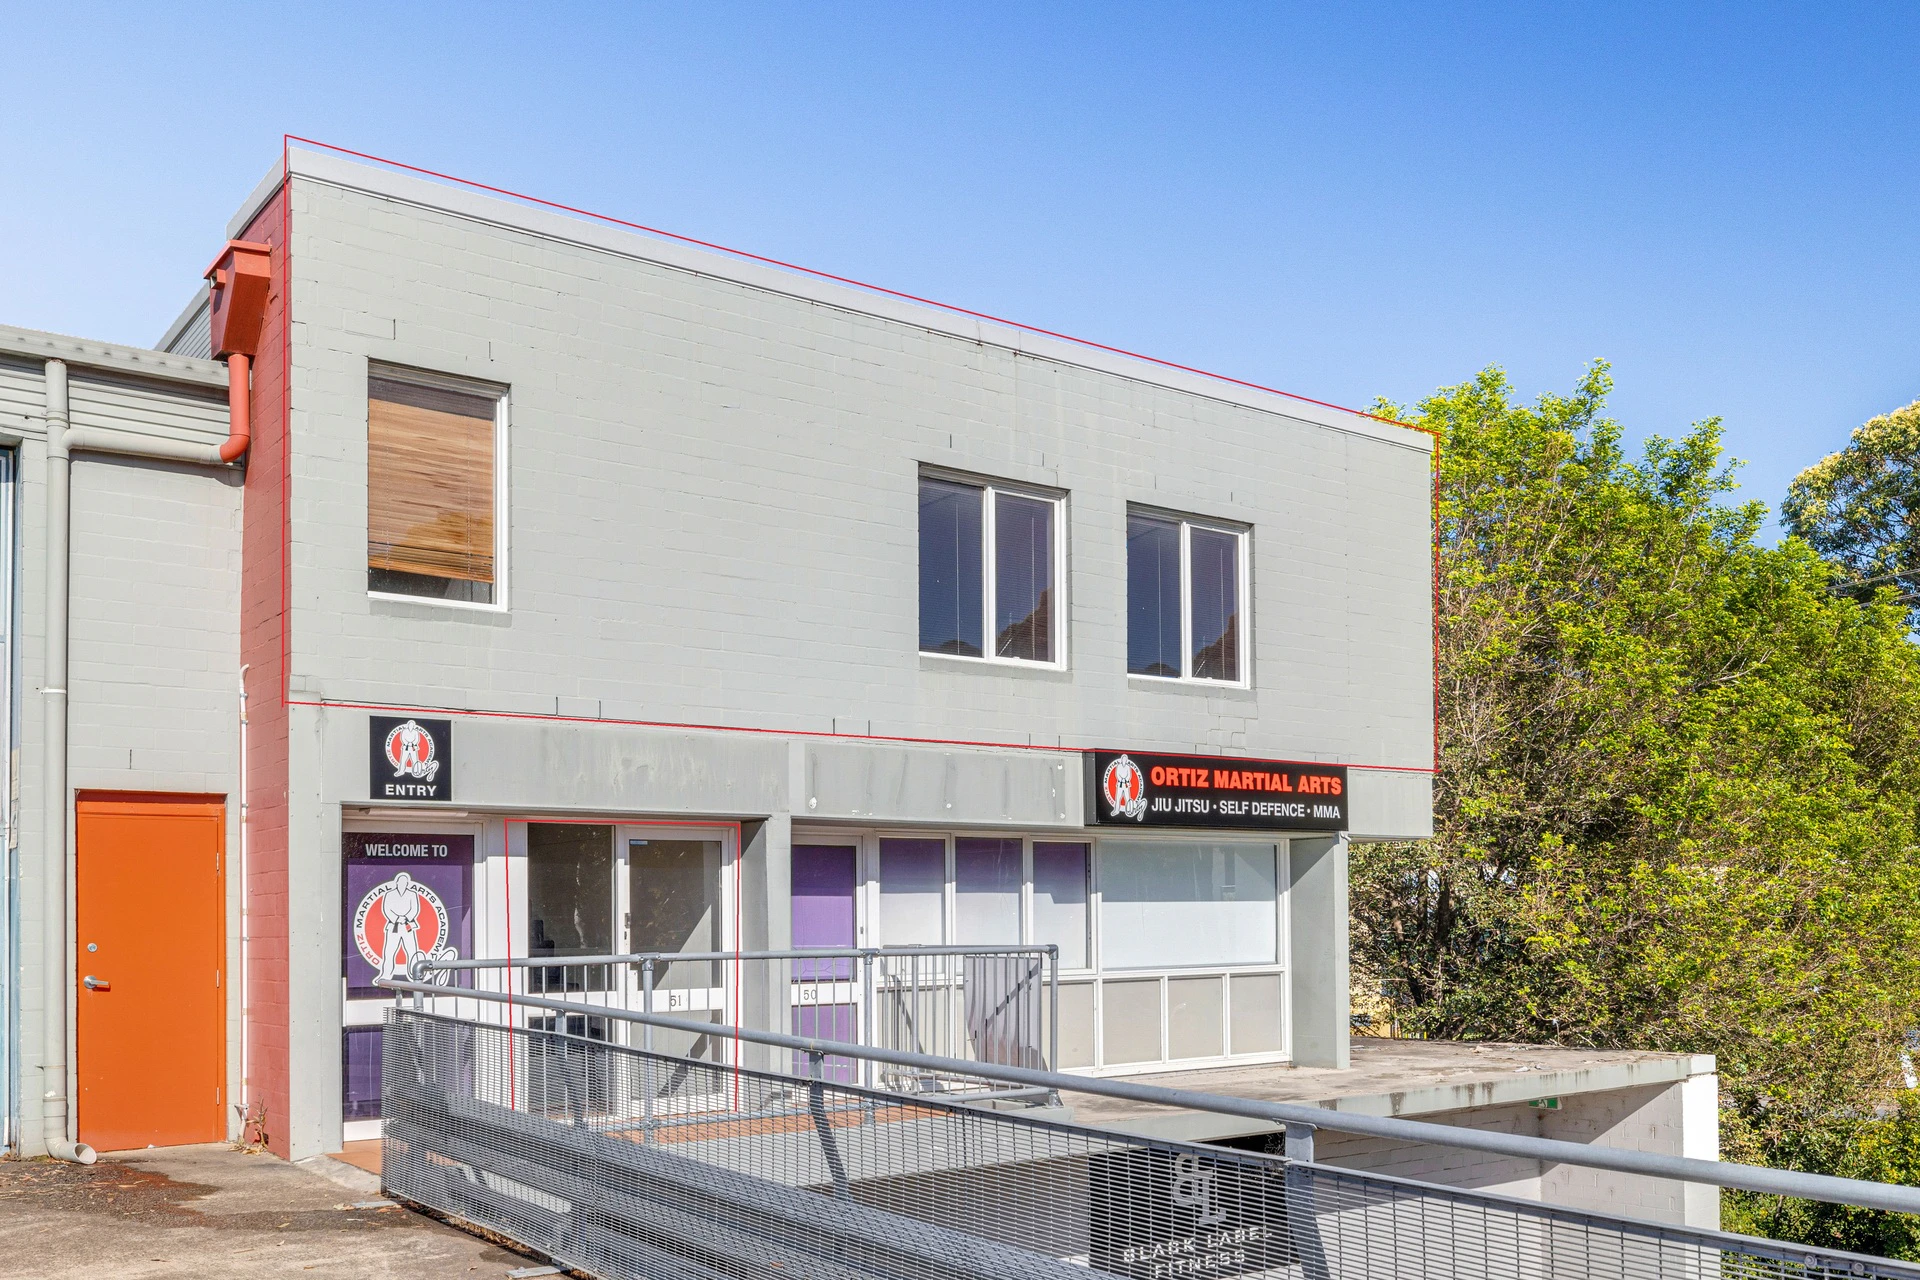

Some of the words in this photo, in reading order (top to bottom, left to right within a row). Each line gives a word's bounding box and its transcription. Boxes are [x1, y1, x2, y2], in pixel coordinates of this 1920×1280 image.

[385, 783, 437, 797] ENTRY
[1151, 766, 1209, 788] ORTIZ
[1213, 769, 1293, 793] MARTIAL
[1297, 775, 1342, 796] ARTS
[1151, 797, 1172, 812] JIU
[1174, 798, 1210, 813] JITSU
[1219, 800, 1249, 815] SELF
[1251, 801, 1305, 818] DEFENCE
[1313, 804, 1341, 819] MMA
[365, 843, 429, 857] WELCOME
[432, 844, 448, 858] TO
[356, 885, 392, 929] MARTIAL
[410, 884, 437, 904] ARTS
[430, 905, 446, 960] ACADEMY
[356, 932, 380, 966] ORTIZ
[669, 994, 682, 1007] 51
[803, 989, 817, 1001] 50
[1123, 1237, 1197, 1264] BLACK
[1206, 1225, 1273, 1249] LABEL
[1154, 1248, 1246, 1279] FITNESS
